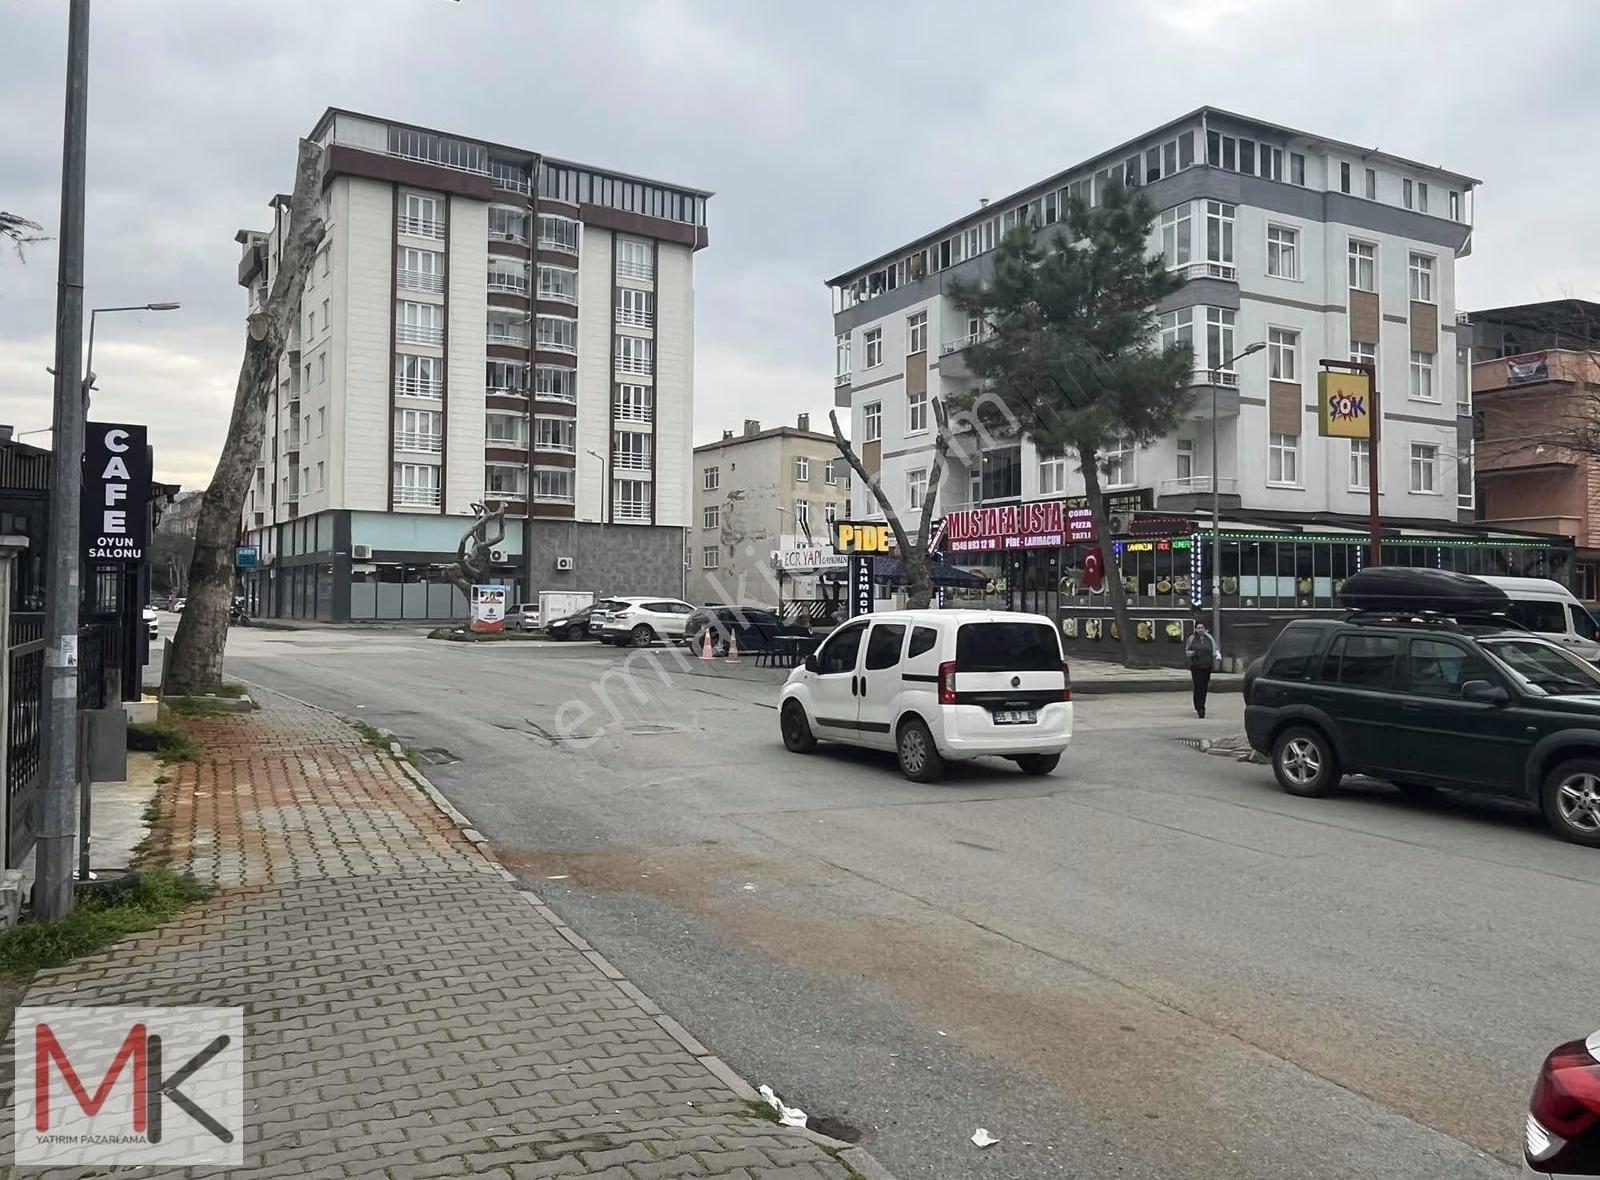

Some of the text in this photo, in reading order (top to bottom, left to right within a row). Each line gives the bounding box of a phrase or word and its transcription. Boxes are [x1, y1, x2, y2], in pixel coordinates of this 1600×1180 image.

[101, 429, 131, 533] CAFE
[948, 506, 1018, 538] MUSTAFA
[1019, 501, 1063, 533] USTA
[97, 537, 133, 547] OYUN
[88, 548, 142, 559] SALONU
[802, 549, 822, 566] YAPI
